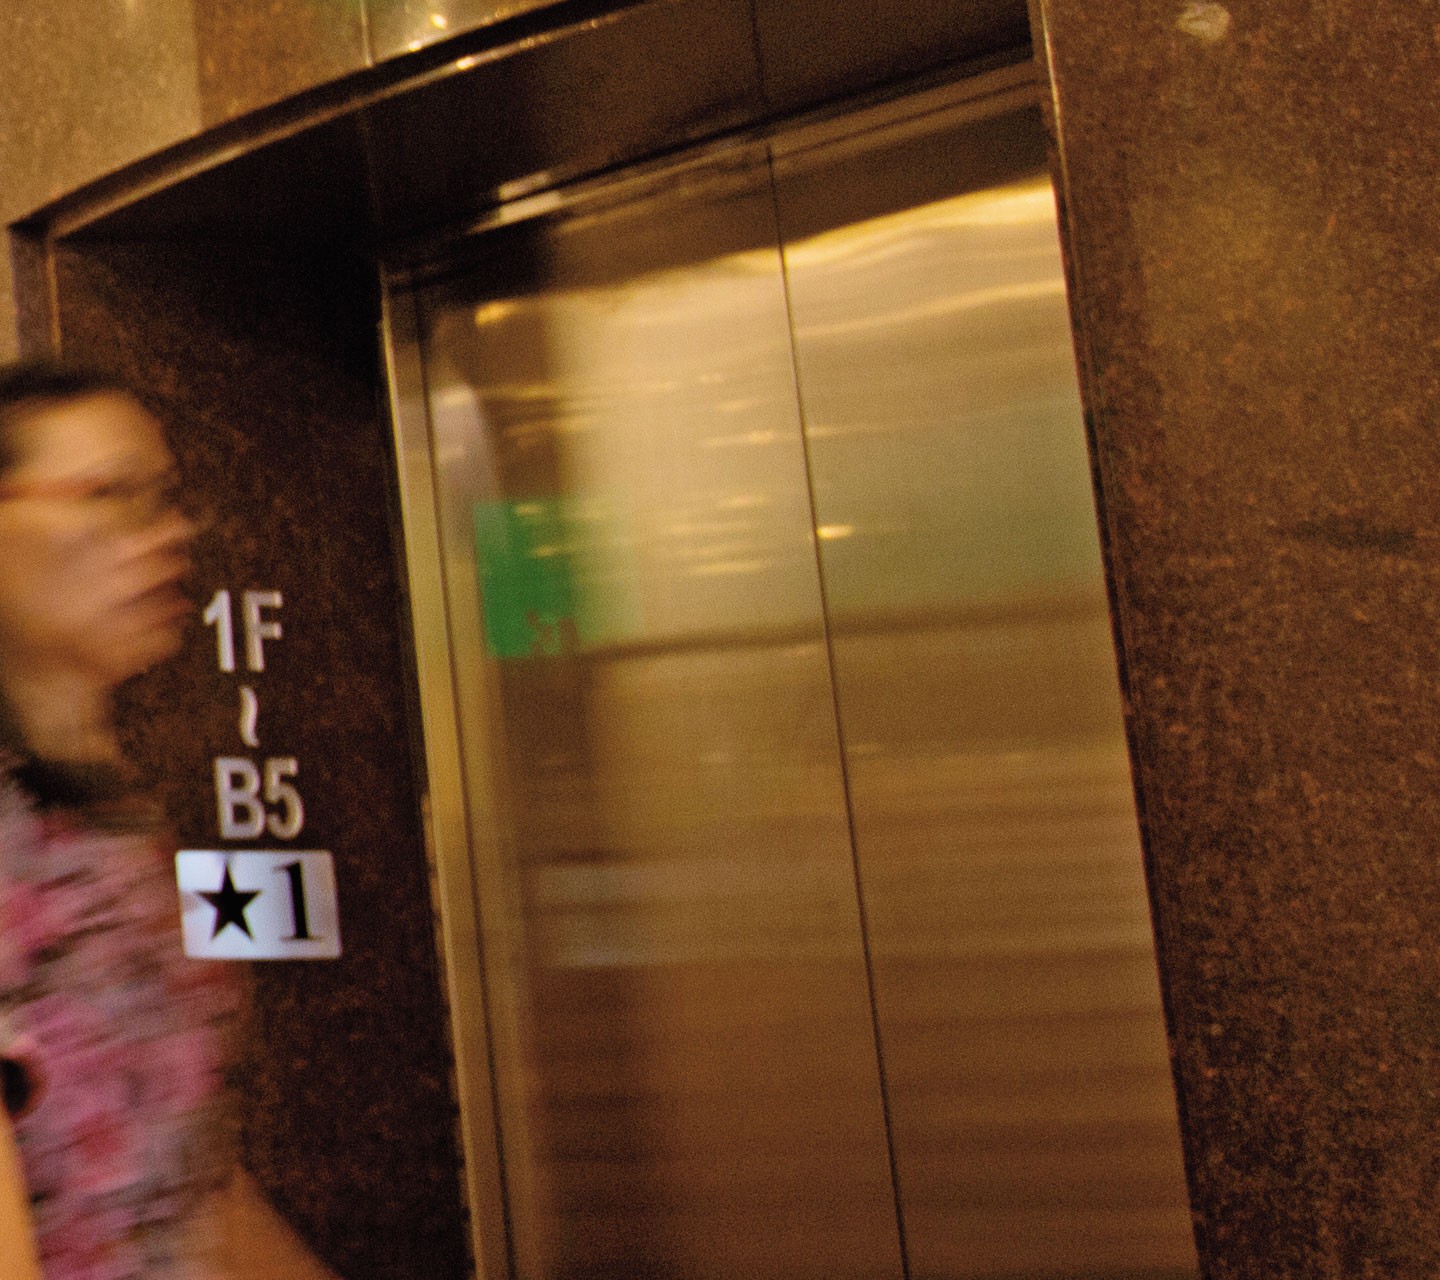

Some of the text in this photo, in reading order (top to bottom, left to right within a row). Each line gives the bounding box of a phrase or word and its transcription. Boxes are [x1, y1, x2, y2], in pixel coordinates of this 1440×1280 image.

[202, 589, 285, 673] 1F
[213, 756, 307, 841] B5
[274, 862, 327, 942] 1
